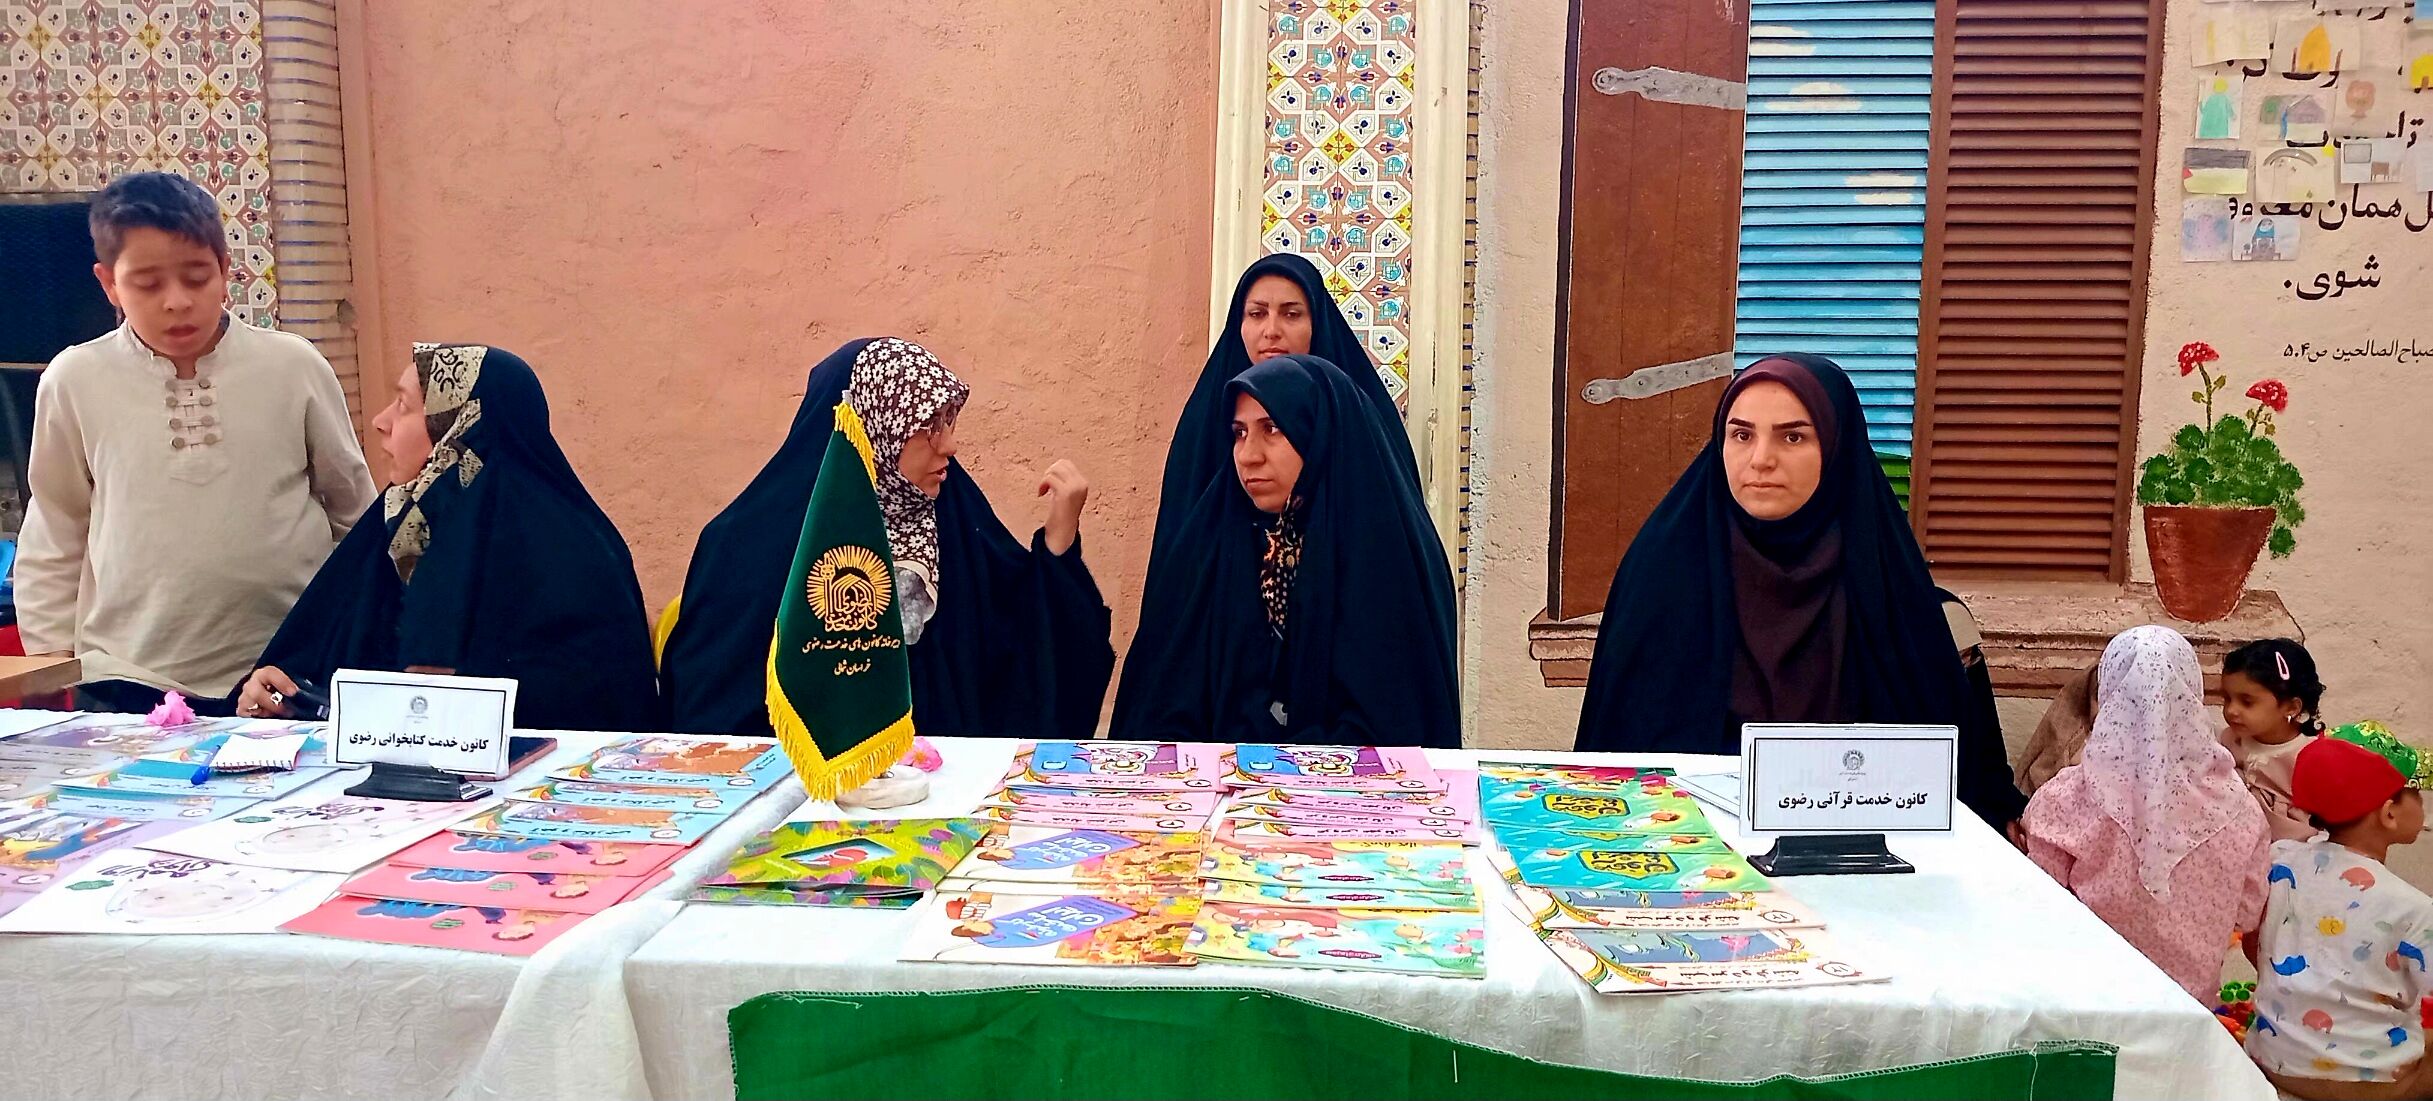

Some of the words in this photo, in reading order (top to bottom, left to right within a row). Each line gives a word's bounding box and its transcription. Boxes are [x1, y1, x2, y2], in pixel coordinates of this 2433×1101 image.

[2318, 183, 2402, 231] همان
[2283, 254, 2382, 301] شوی.
[349, 730, 377, 746] رضوی
[378, 731, 427, 748] کتابخوانی
[428, 737, 458, 748] خدمت
[460, 739, 489, 752] کانون
[1778, 792, 1815, 809] رضوی
[1855, 793, 1893, 808] خدمت
[1895, 792, 1929, 809] کانون
